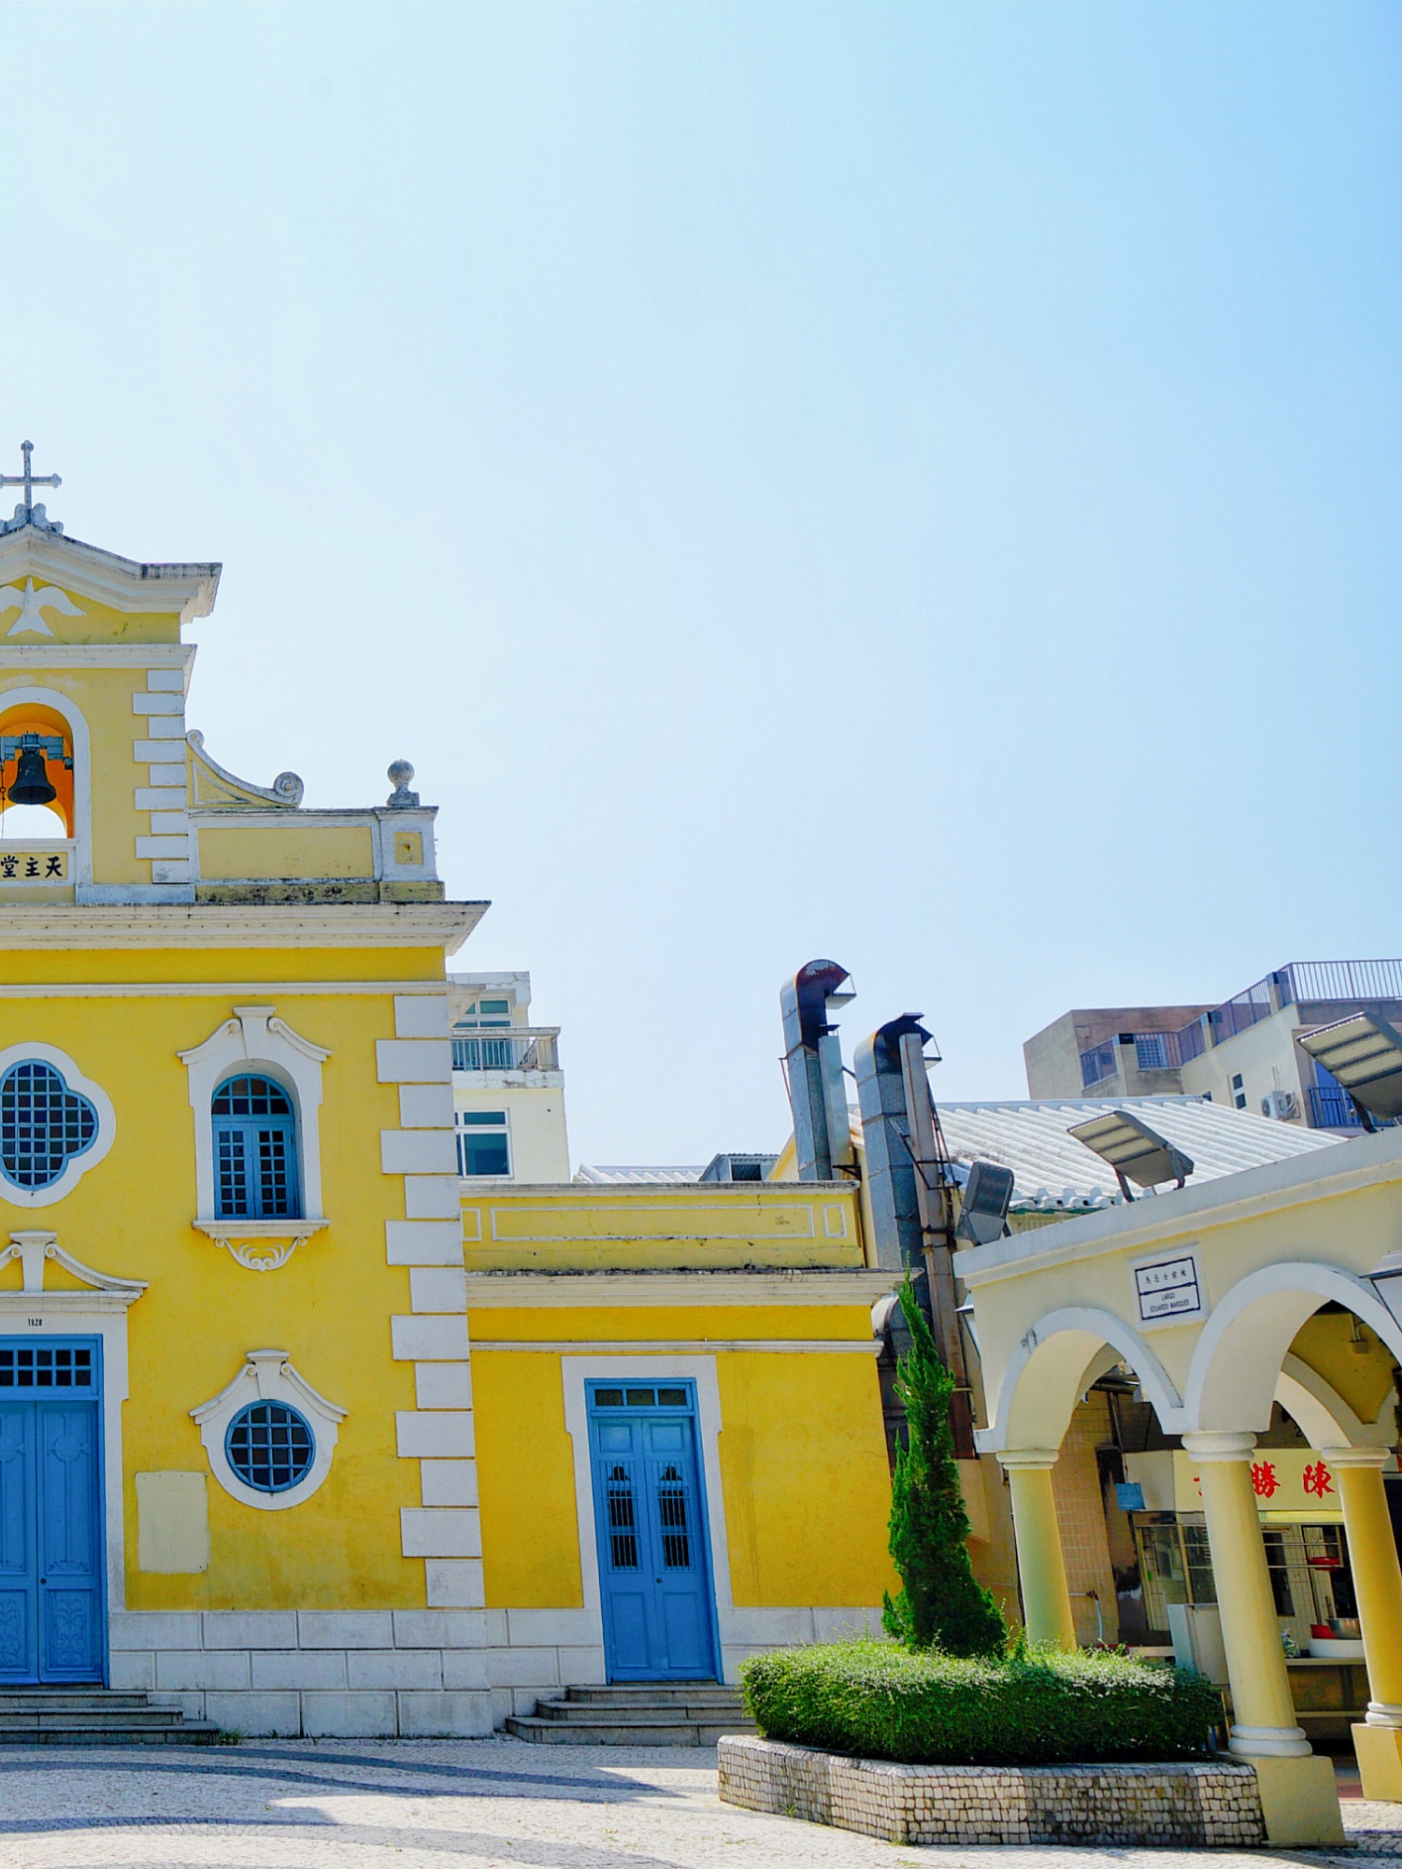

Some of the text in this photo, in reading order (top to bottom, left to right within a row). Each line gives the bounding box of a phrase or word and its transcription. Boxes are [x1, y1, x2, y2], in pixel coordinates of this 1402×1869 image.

[1161, 1292, 1175, 1301] LARGO
[1170, 1299, 1189, 1309] MARQUES
[27, 1318, 43, 1327] 1928
